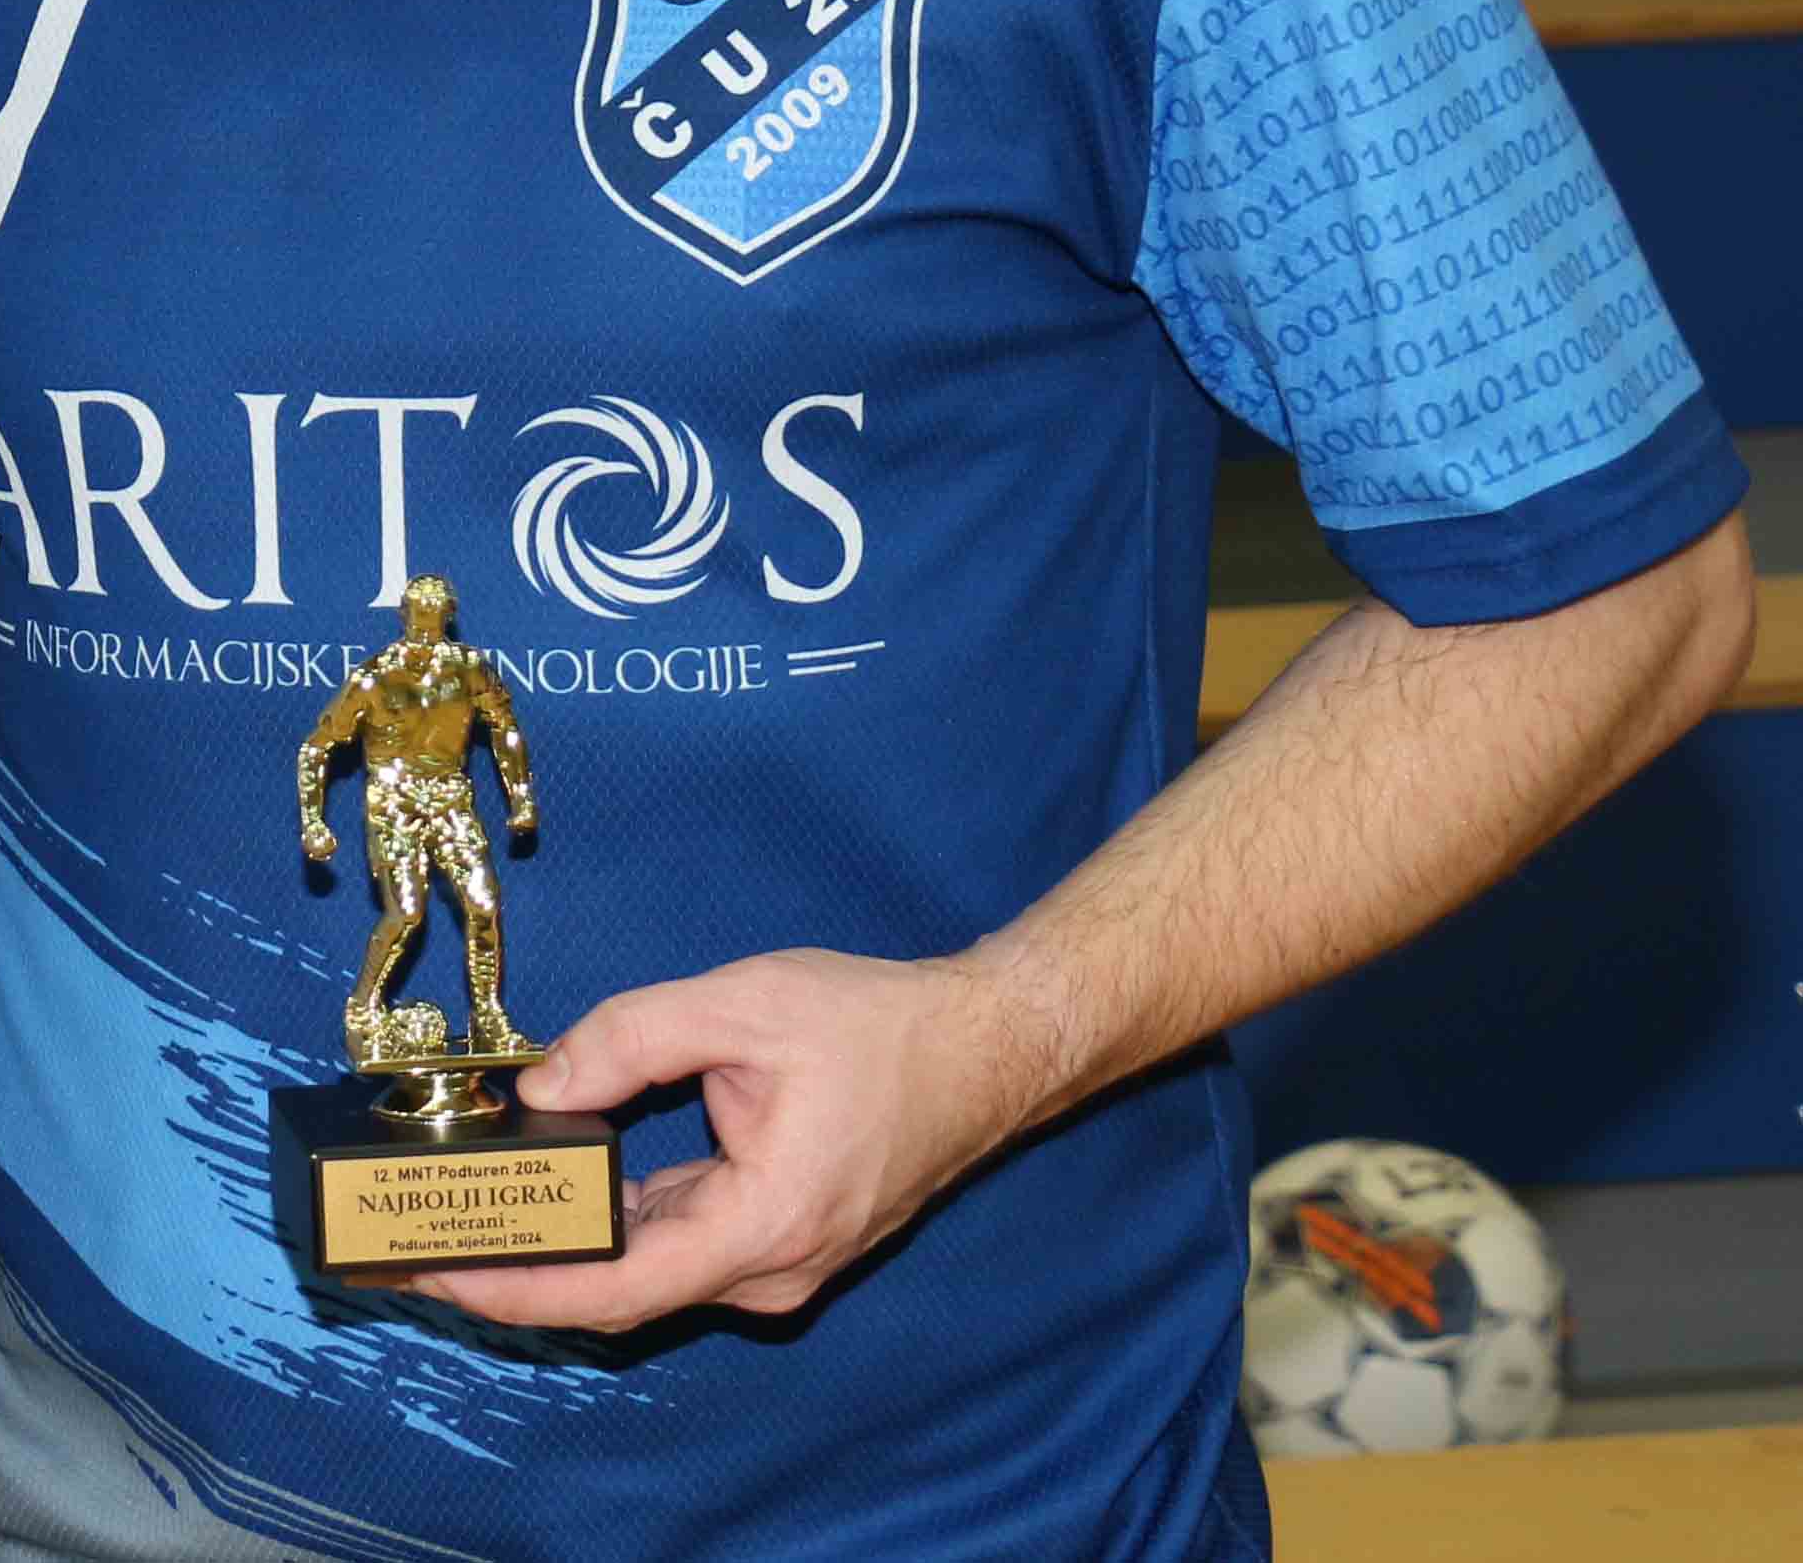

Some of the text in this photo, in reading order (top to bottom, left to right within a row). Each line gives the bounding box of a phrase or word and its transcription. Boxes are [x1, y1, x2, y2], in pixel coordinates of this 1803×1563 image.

[726, 64, 848, 181] 2009
[483, 644, 768, 697] NOLOGIJE
[373, 1160, 556, 1184] 12. MNT Podturen 2024.
[357, 1178, 575, 1217] NAJBOLJI IGRAČ
[428, 1213, 505, 1233] veterani
